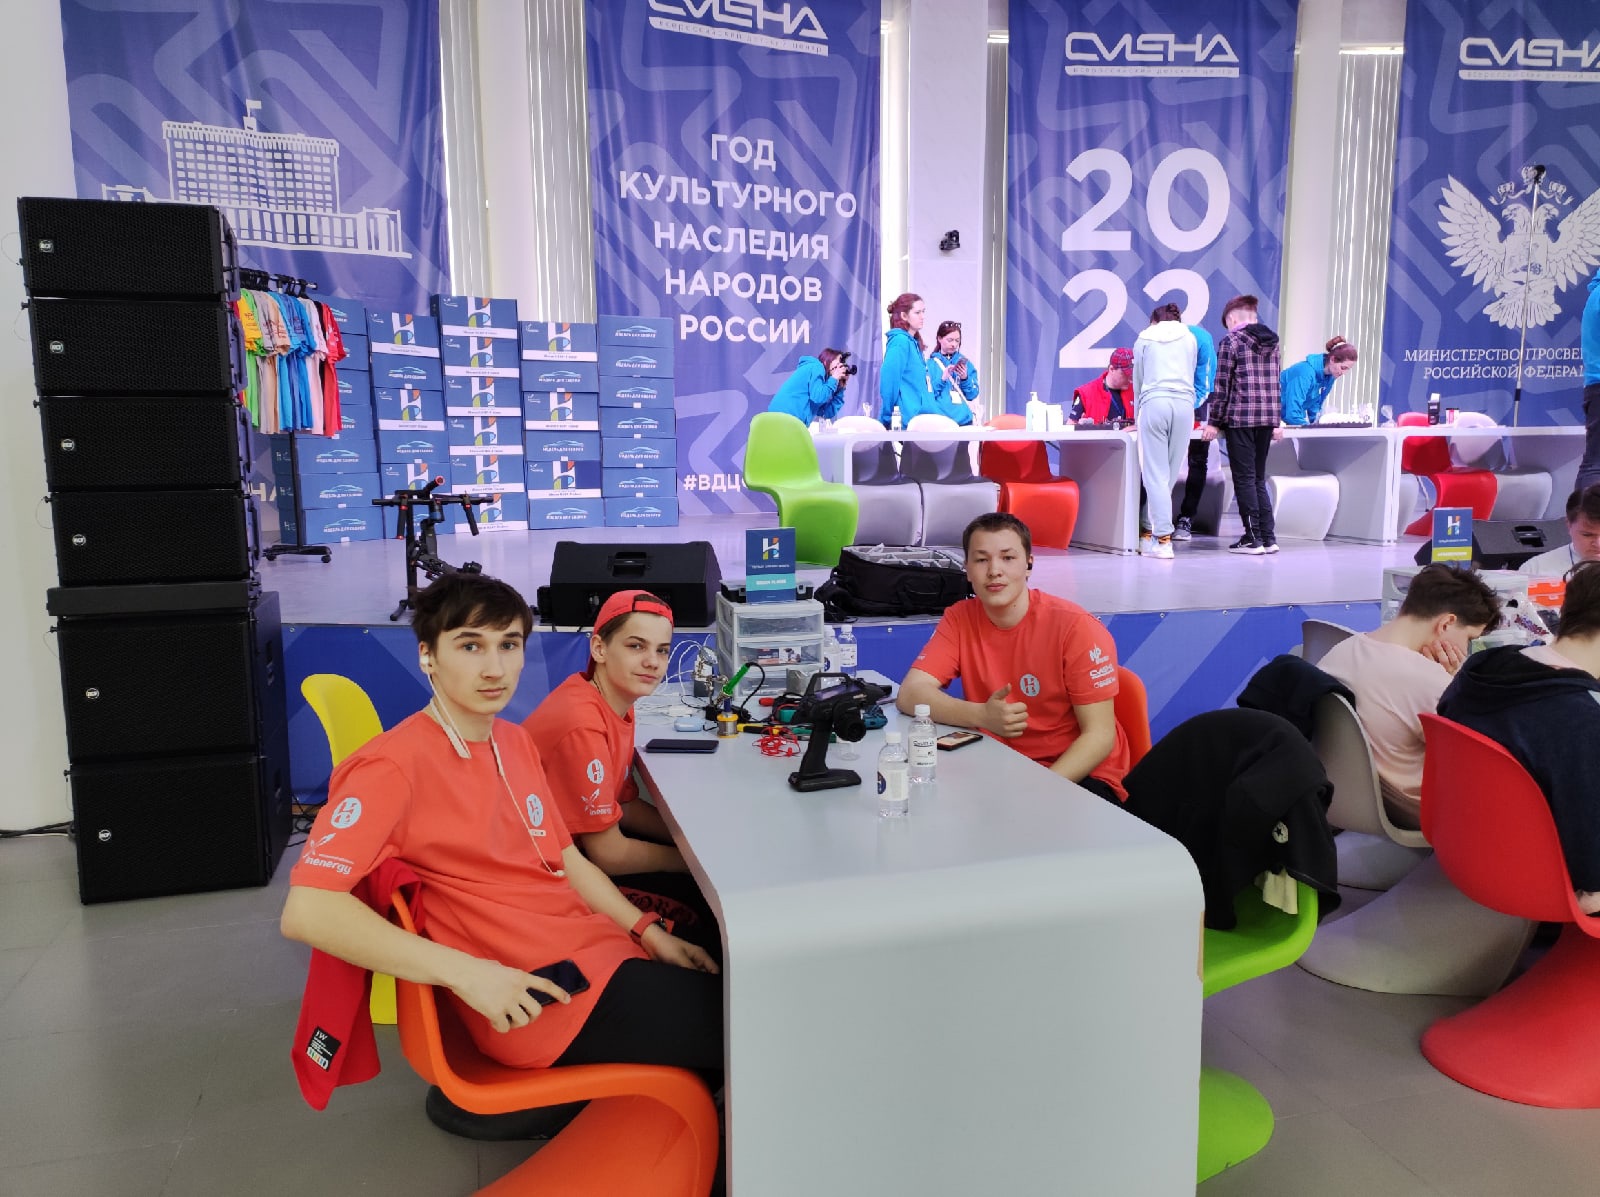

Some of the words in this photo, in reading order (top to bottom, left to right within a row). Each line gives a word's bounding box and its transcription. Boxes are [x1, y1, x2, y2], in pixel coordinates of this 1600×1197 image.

[711, 133, 776, 171] ГОД
[619, 170, 857, 218] КУЛЬТУРНОГО
[1062, 148, 1230, 252] 20
[654, 220, 829, 262] НАСЛЕДИЯ
[665, 268, 823, 304] НАРОДОВ
[680, 314, 811, 344] РОССИИ
[1403, 348, 1520, 362] МИНИСТЕРСТВО
[1525, 347, 1583, 361] ПРОСВЕ
[1423, 363, 1518, 379] РОССИЙСКОЙ
[683, 473, 747, 493] #ВДЦ
